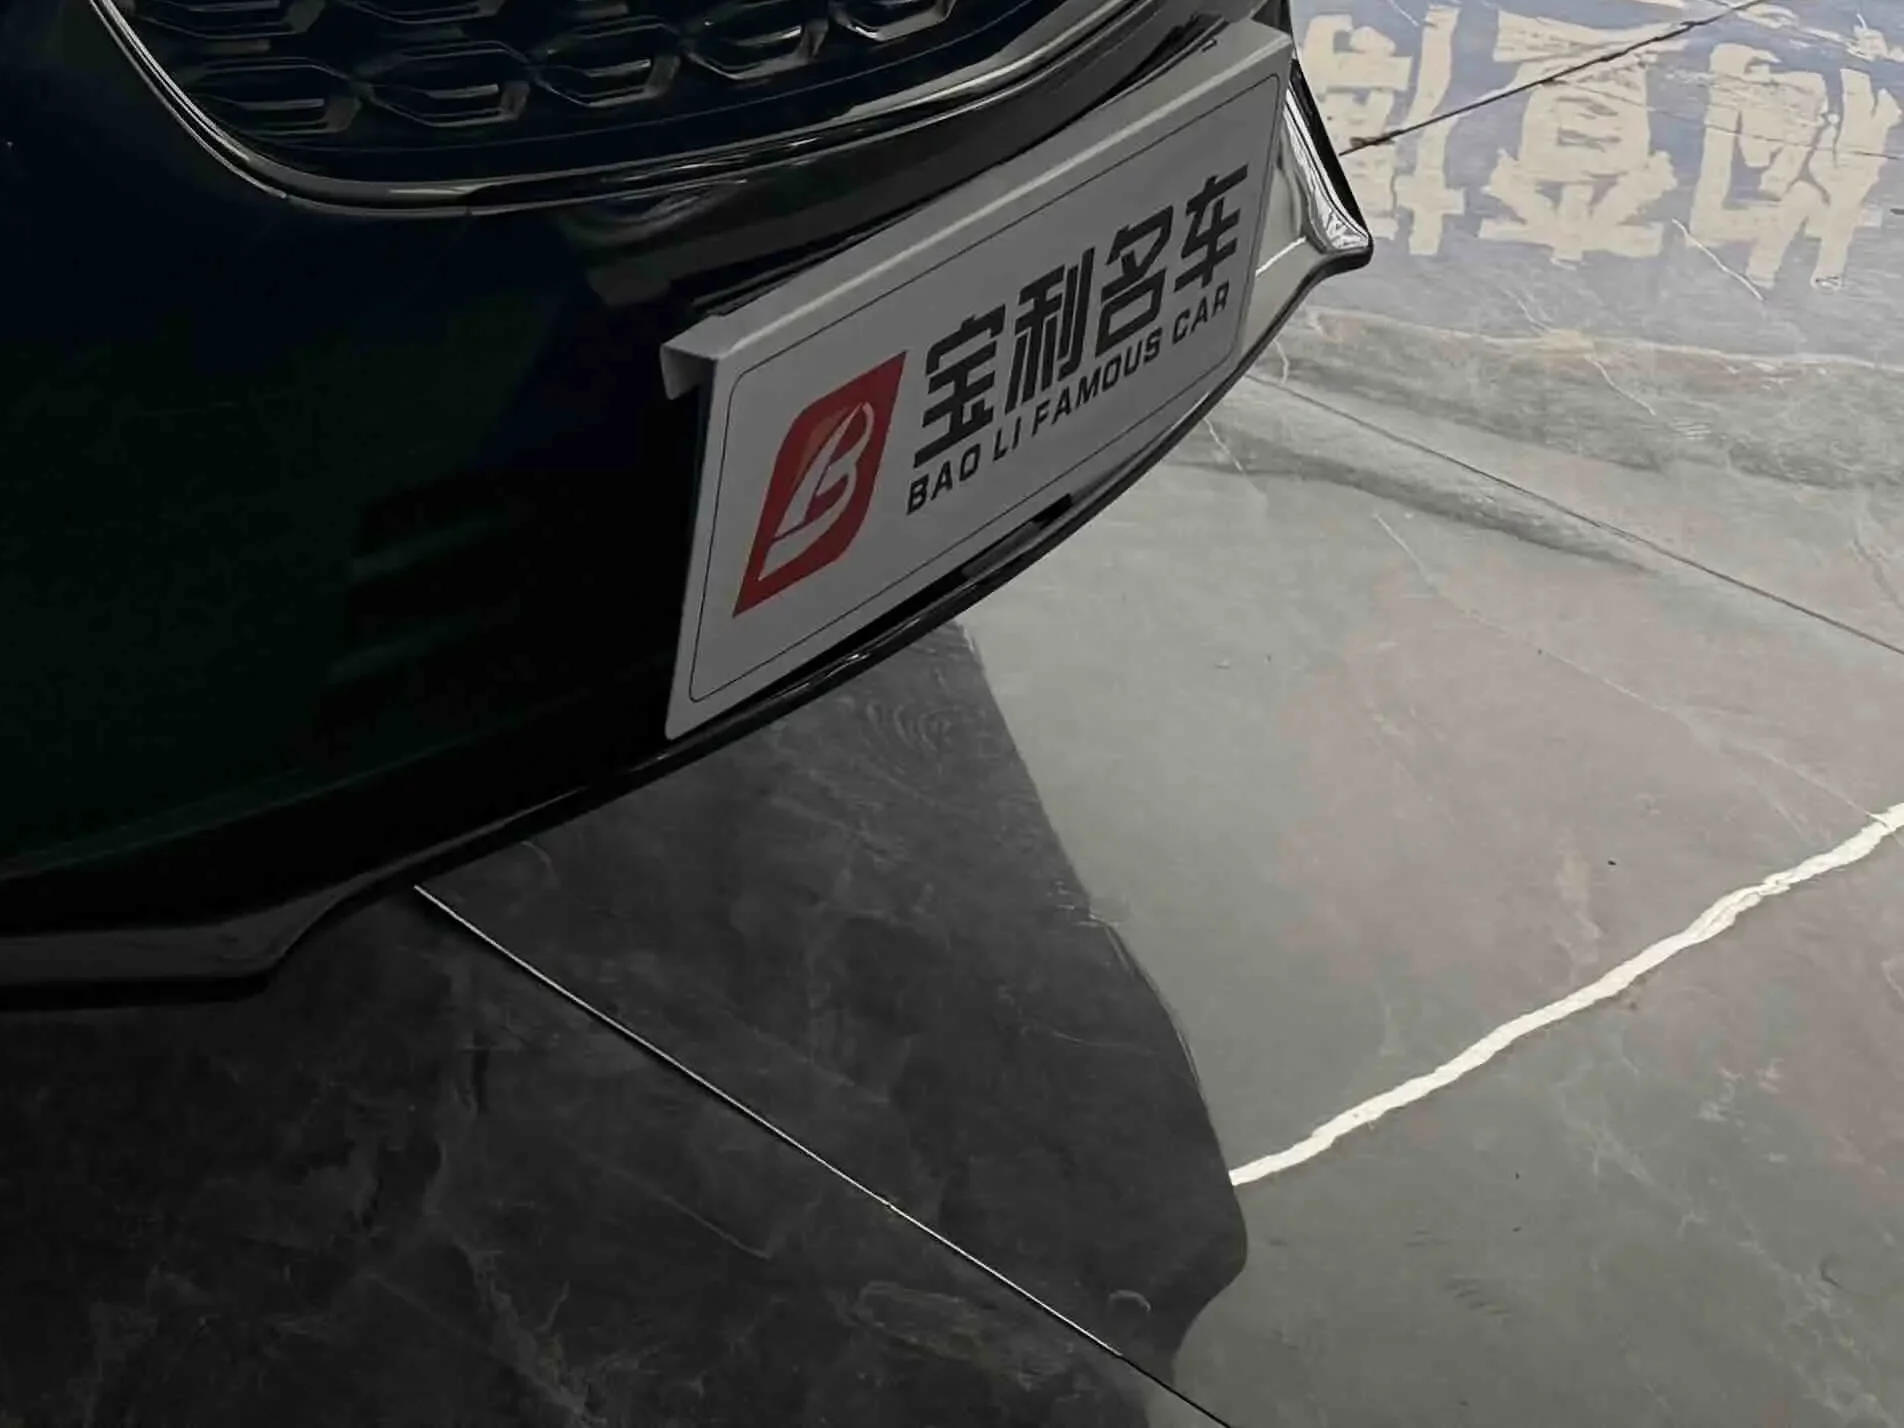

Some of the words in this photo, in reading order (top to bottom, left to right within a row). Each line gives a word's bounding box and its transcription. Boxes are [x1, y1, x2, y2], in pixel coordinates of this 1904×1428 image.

[905, 442, 982, 517] BAO
[992, 415, 1024, 462] LI
[1031, 326, 1164, 438] FAMOUS
[1170, 280, 1232, 346] CAR
[913, 163, 1249, 470] 宝利名车
